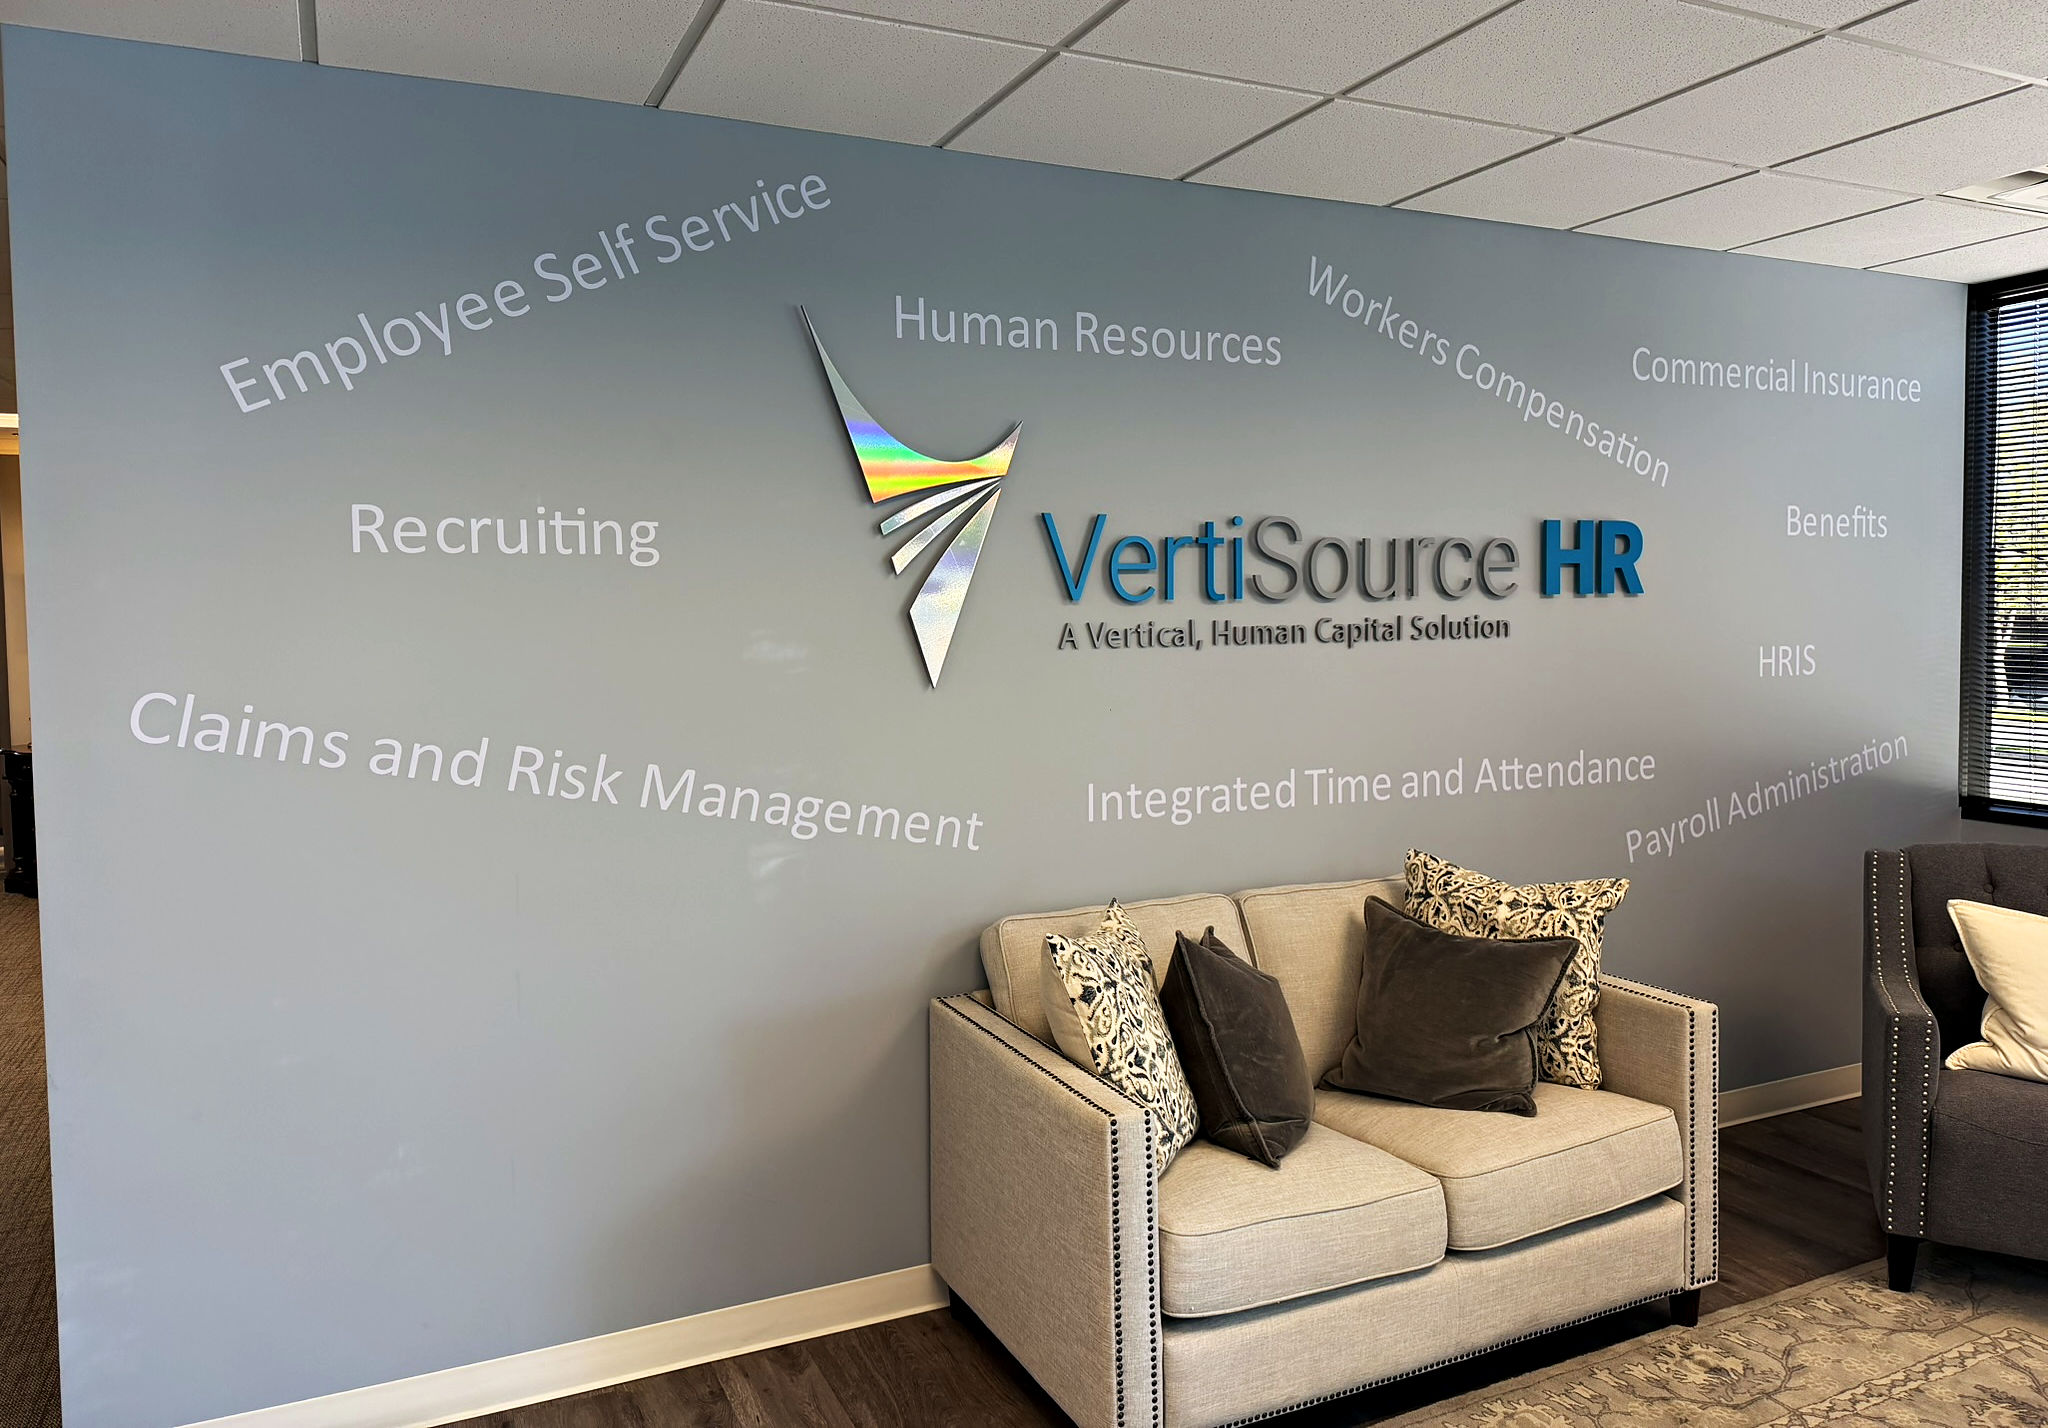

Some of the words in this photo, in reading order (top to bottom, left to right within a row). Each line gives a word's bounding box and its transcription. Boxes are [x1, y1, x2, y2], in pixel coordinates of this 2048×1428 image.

[220, 280, 531, 413] Employee
[534, 222, 640, 303] Self
[645, 174, 832, 264] Service
[895, 295, 1058, 352] Human
[1077, 311, 1282, 366] Resources
[1309, 255, 1450, 366] Workers
[1456, 343, 1669, 488] Compensation
[1632, 346, 1796, 394] Commercial
[1804, 362, 1921, 403] Insurance
[351, 504, 660, 567] Recruiting
[1041, 512, 1520, 602] VertiSource
[1540, 518, 1645, 597] HR
[1787, 504, 1888, 538] Benefits
[1058, 622, 1078, 650] A
[1087, 619, 1203, 650] Vertical,
[1212, 619, 1306, 646] Human
[1314, 615, 1402, 649] Capital
[1410, 615, 1511, 641] Solution
[1759, 644, 1816, 678] HRIS
[130, 692, 349, 769] Claims
[369, 737, 489, 788] and
[507, 745, 624, 805] Risk
[639, 763, 984, 851] Management
[1088, 768, 1296, 826] Integrated
[1304, 768, 1392, 808] Time
[1401, 757, 1463, 799] and
[1474, 749, 1657, 795] Attendance
[1625, 796, 1721, 864] Payroll
[1728, 735, 1909, 827] Administration
